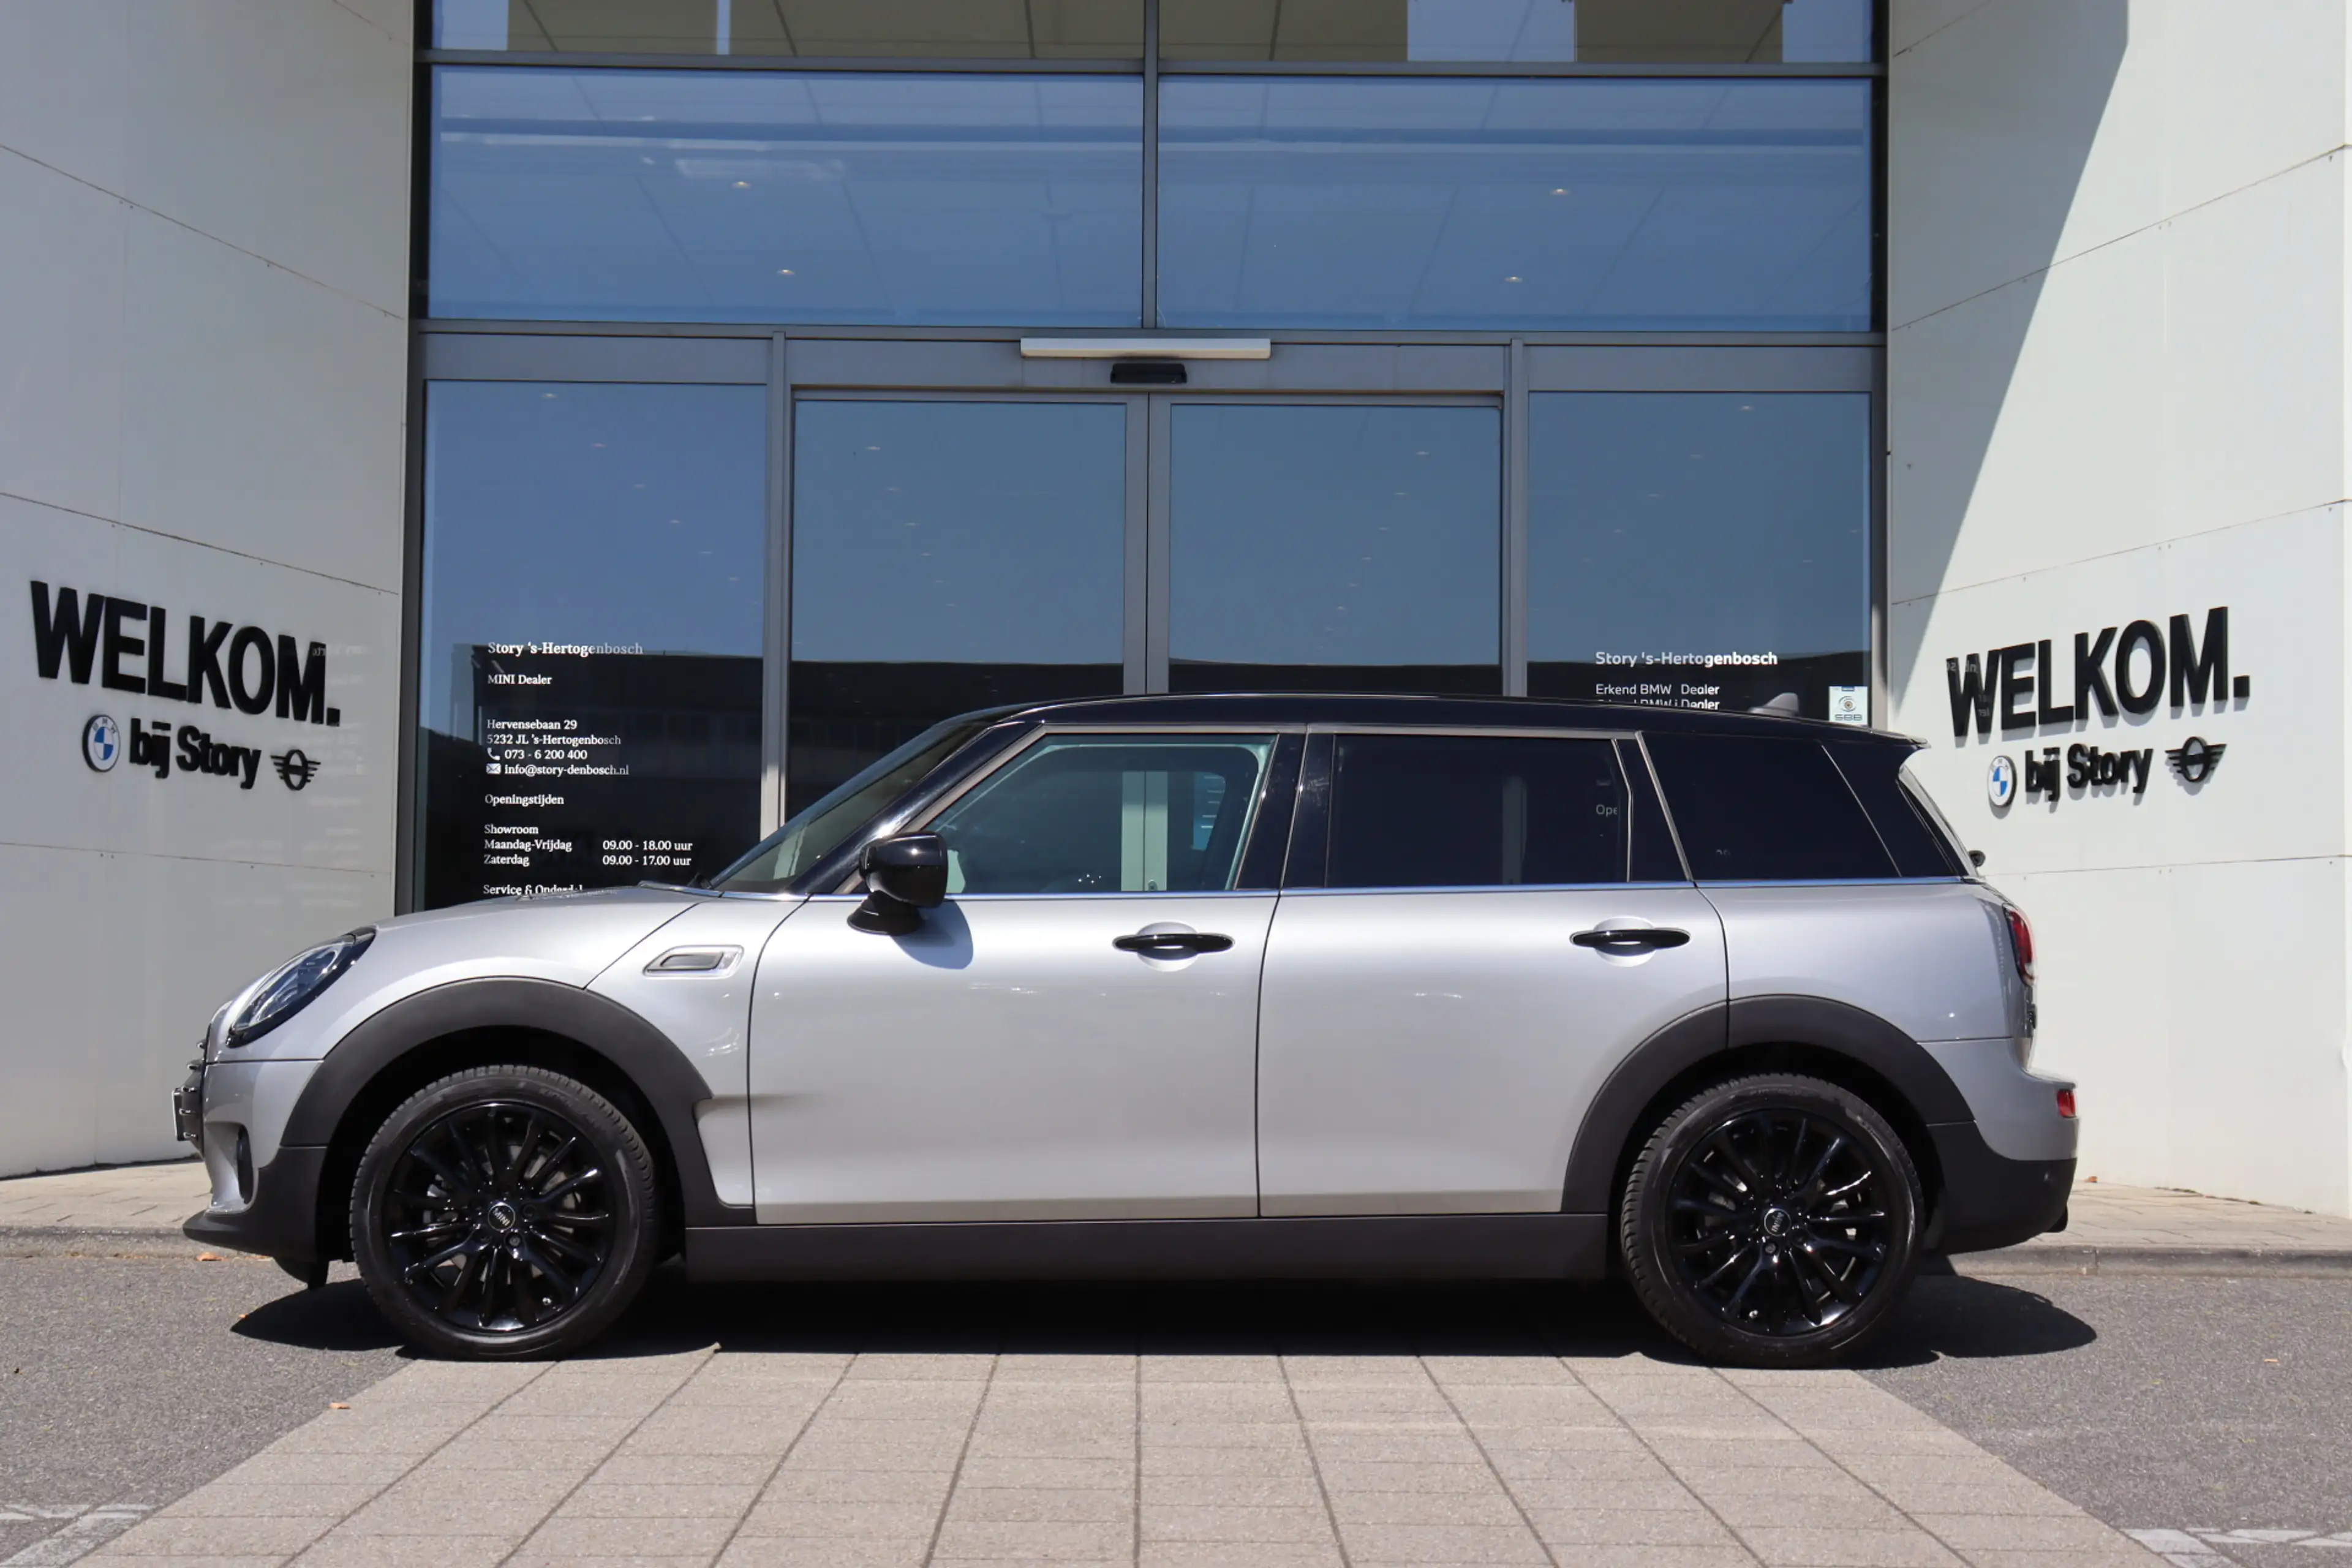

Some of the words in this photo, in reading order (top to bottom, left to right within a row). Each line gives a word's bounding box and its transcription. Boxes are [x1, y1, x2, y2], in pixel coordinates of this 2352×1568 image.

[30, 580, 341, 727] WELKOM.
[488, 643, 524, 657] Story
[1596, 651, 1637, 667] Story
[1641, 651, 1777, 668] 's-Hertogenbosch
[1946, 606, 2250, 738] WELKOM.
[488, 674, 515, 685] MINI
[518, 674, 552, 685] Dealer
[1596, 684, 1637, 695] Erkend
[1640, 684, 1672, 695] BMW
[1681, 684, 1720, 695] Dealer
[487, 719, 561, 730] Hervensebaan
[564, 720, 578, 730] 29
[487, 734, 513, 745] 5232
[515, 734, 529, 745] JL
[531, 734, 621, 747] 's-Hertogenbosch
[176, 725, 262, 790] Story
[504, 749, 525, 760] 073
[533, 749, 541, 760] 6
[544, 749, 565, 760] 200
[567, 749, 588, 760] 400
[504, 764, 629, 777] info@story-denbosch.nl
[2067, 743, 2154, 794] Story
[484, 793, 565, 807] Openingstijden
[484, 824, 539, 835] Showroom
[484, 839, 573, 852] Maandag-Vrijdag
[602, 840, 633, 851] 09.00
[643, 840, 672, 851] 18.00
[674, 842, 693, 851] uur
[484, 854, 530, 867] Zaterdag
[602, 855, 633, 865] 09.00
[643, 855, 671, 865] 17.00
[483, 884, 522, 895] Service
[492, 1208, 511, 1226] MINI
